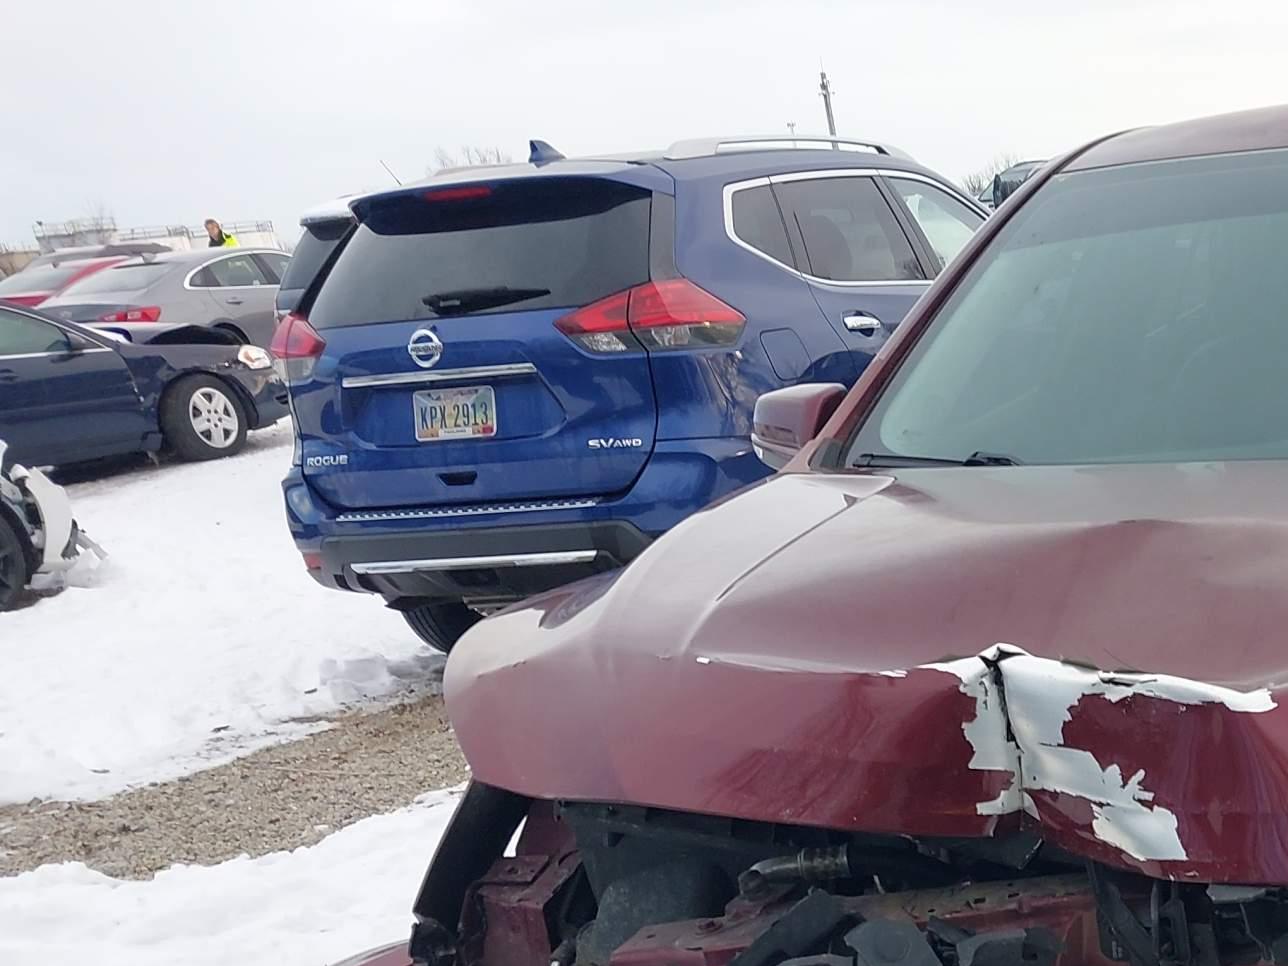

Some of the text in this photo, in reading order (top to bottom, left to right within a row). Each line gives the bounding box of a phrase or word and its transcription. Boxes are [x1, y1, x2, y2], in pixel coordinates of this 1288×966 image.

[420, 402, 488, 430] KPX 2913
[307, 455, 348, 467] ROGUE
